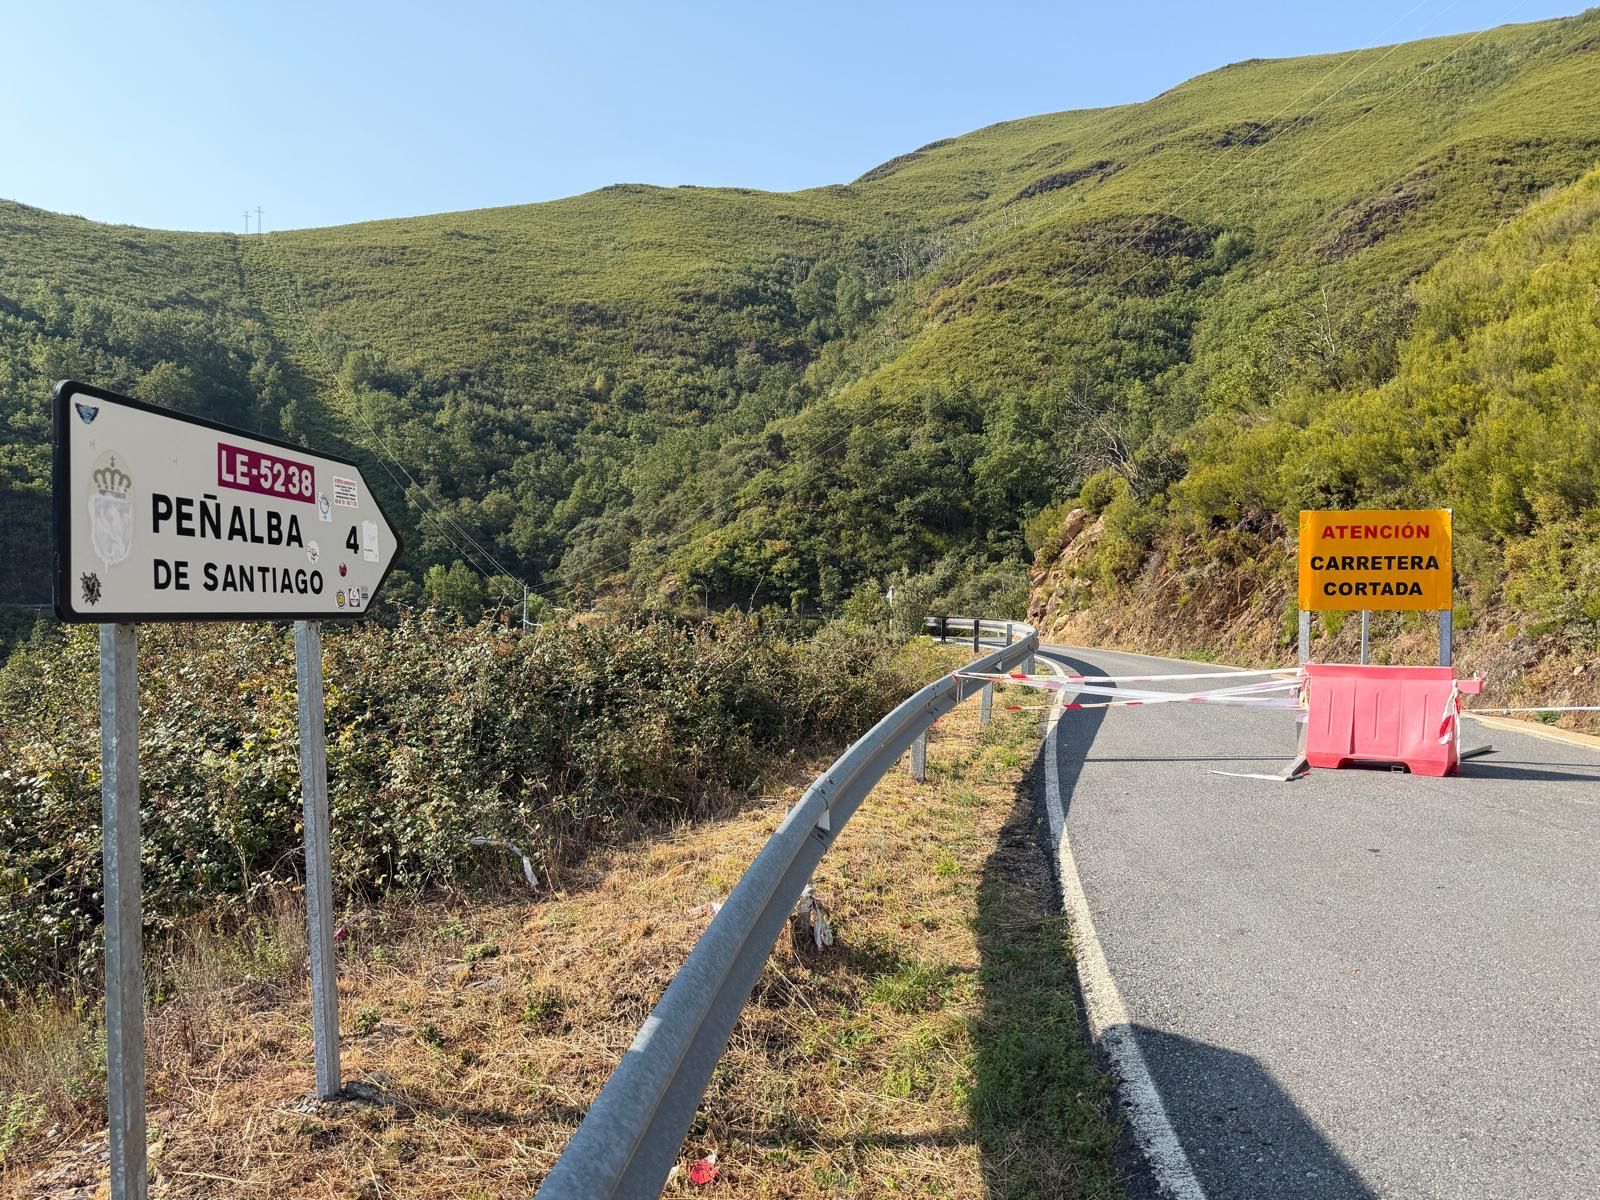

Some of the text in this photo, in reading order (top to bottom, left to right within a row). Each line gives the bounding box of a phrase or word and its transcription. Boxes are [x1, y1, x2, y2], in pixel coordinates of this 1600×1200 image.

[221, 449, 313, 497] LE-5238
[152, 493, 304, 549] PEÑALBA
[1322, 522, 1430, 539] ATENCIÓN
[345, 526, 360, 555] 4
[153, 559, 323, 595] DE SANTIAGO
[1310, 555, 1439, 570] CARRETERA
[1323, 581, 1423, 596] CORTADA
